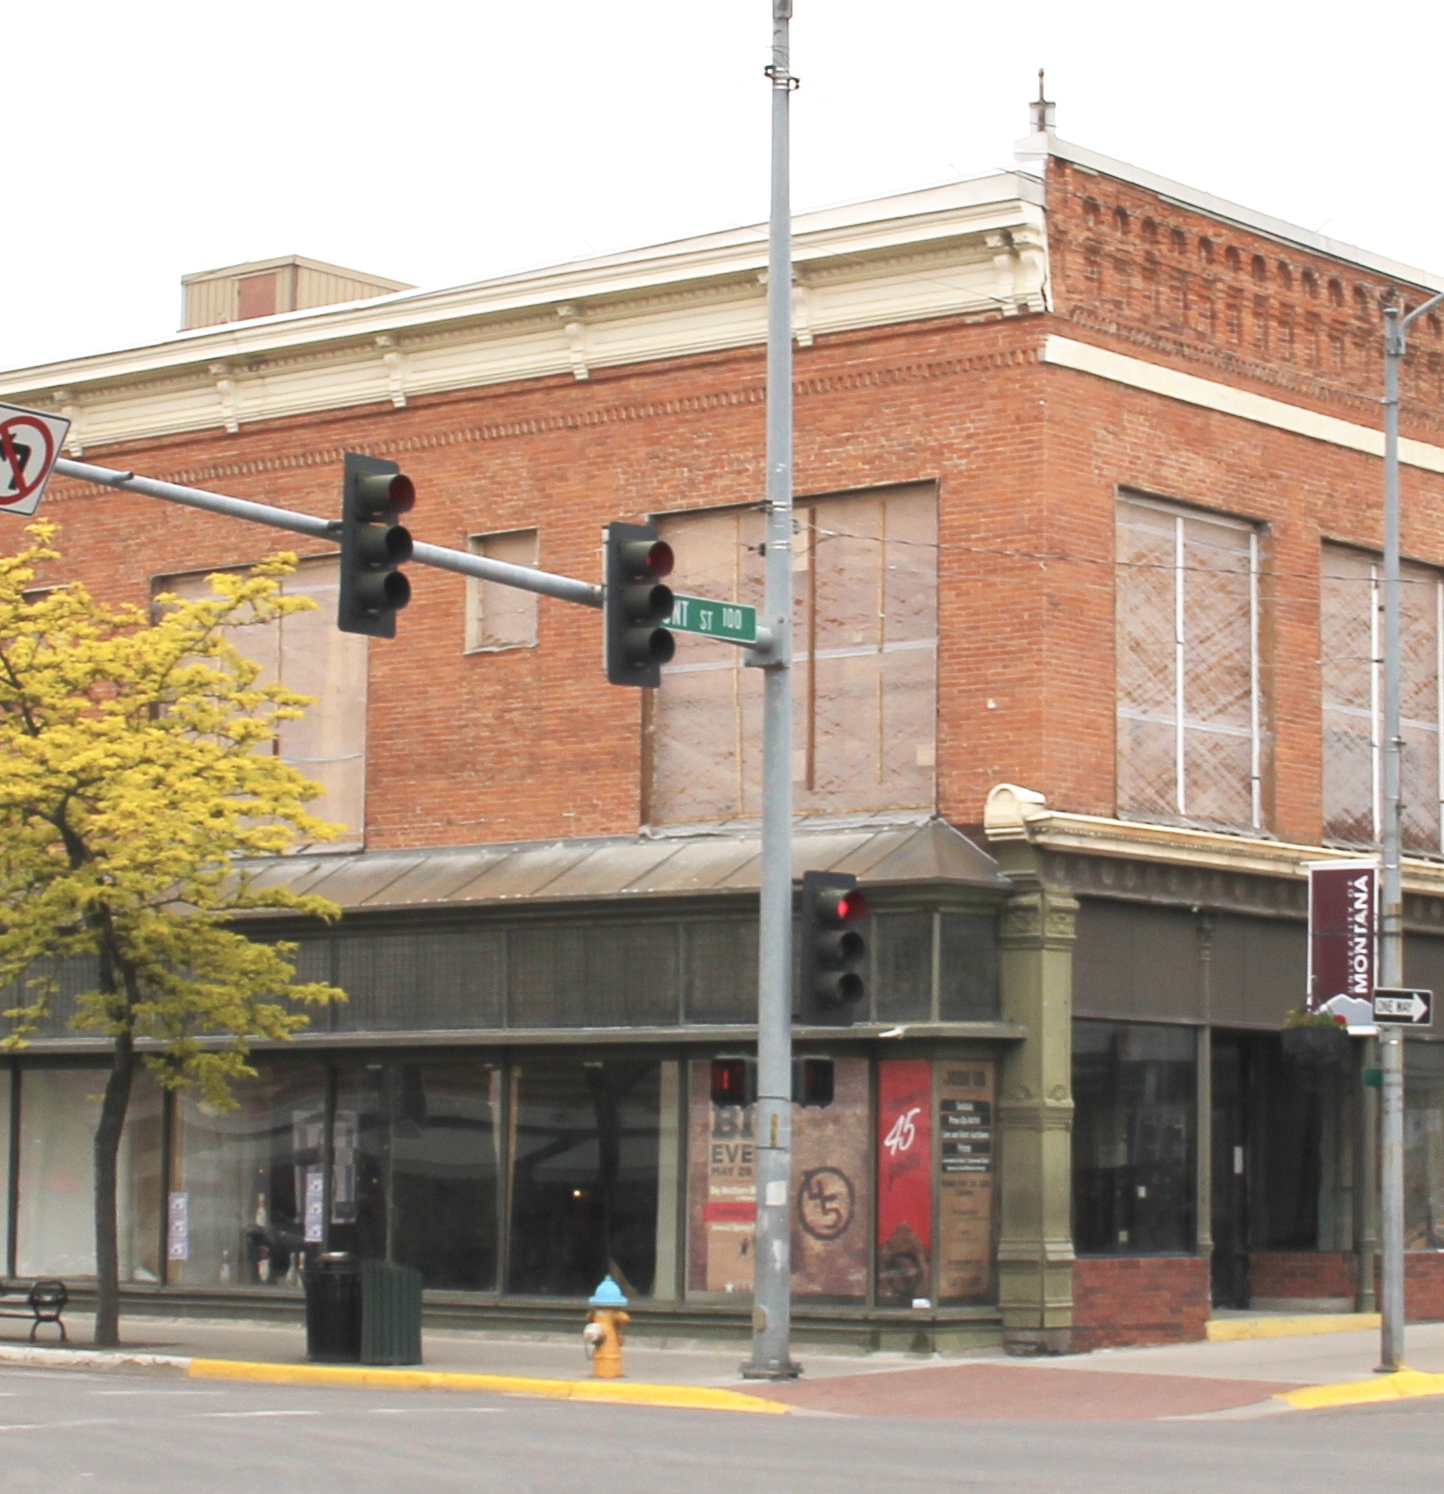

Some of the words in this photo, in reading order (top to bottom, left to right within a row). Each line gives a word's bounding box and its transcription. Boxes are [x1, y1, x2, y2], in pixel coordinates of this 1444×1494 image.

[699, 609, 713, 630] ST
[722, 607, 743, 630] 100
[1354, 875, 1369, 994] MONTANA
[1376, 1000, 1394, 1013] ONE
[1396, 1000, 1413, 1014] WAY
[883, 1106, 922, 1157] 45
[711, 1144, 754, 1164] EVE
